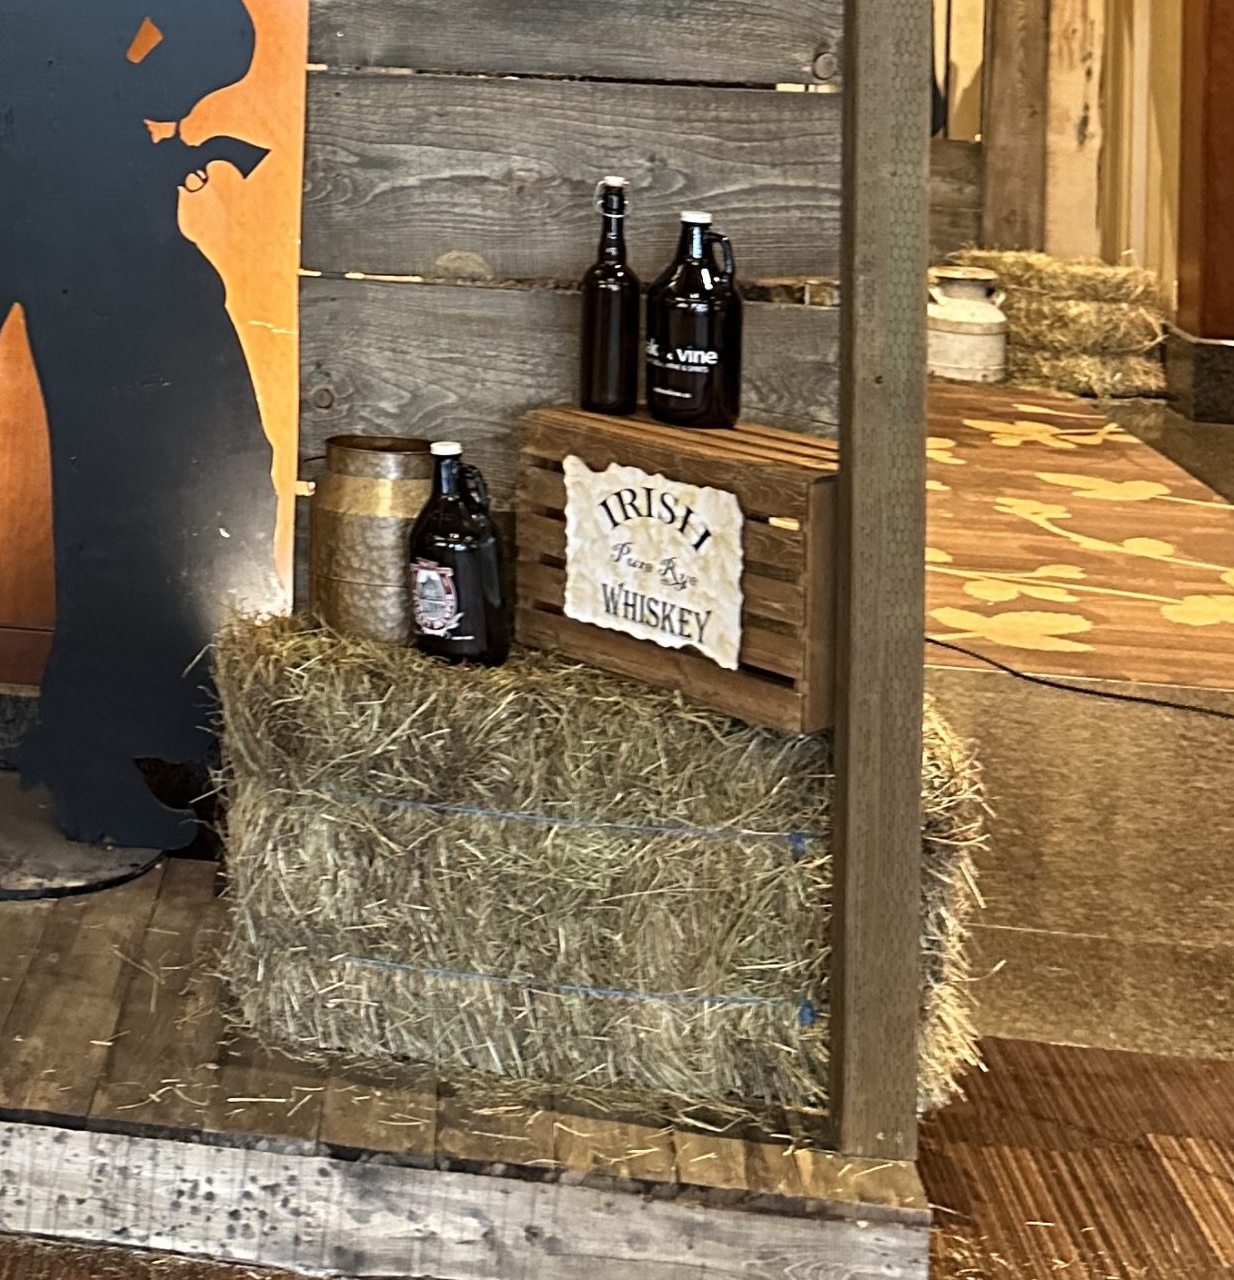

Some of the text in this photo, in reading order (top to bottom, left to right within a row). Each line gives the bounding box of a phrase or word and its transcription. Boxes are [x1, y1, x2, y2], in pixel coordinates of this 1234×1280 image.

[676, 346, 718, 365] vine
[599, 486, 712, 551] IRISH
[610, 542, 699, 591] Pure Rye
[601, 581, 712, 644] WHISKEY
